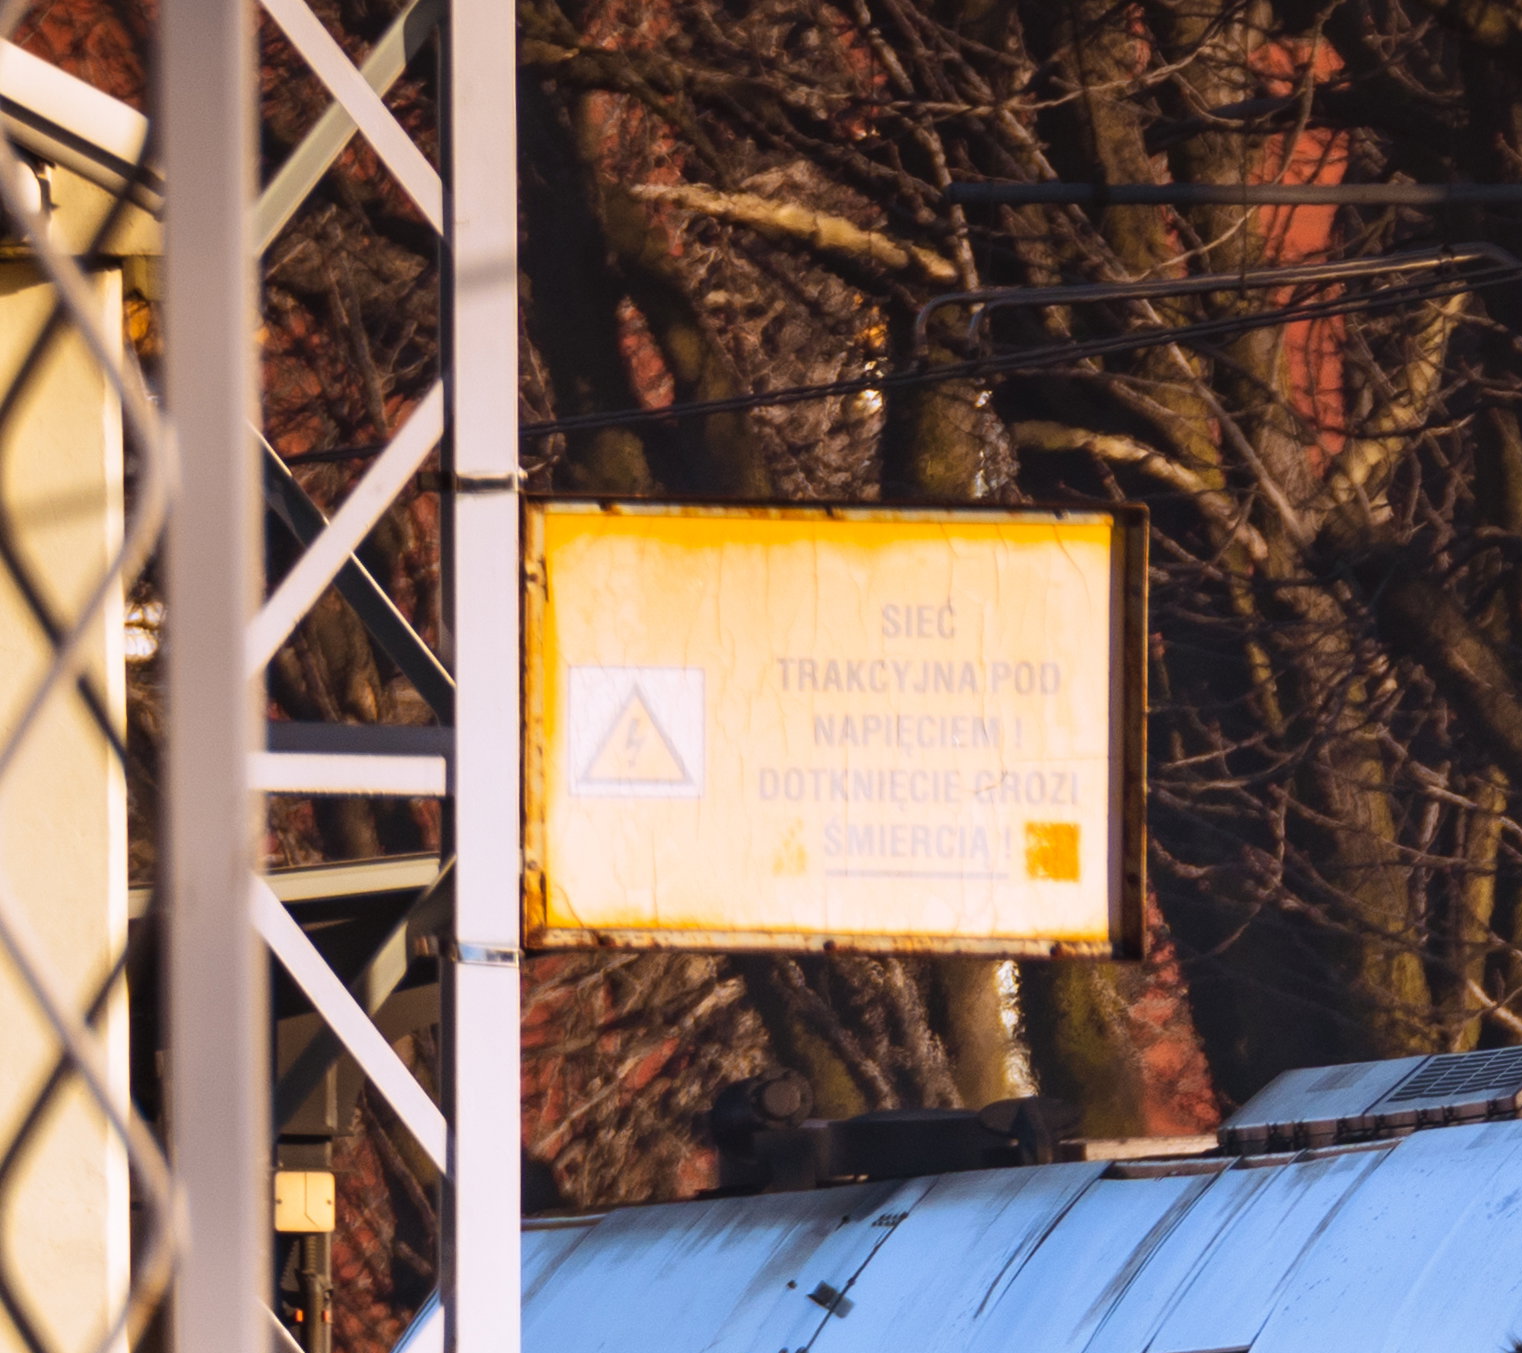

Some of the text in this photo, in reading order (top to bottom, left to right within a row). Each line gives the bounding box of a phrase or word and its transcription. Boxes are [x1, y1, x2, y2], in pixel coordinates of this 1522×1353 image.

[776, 657, 1062, 696] TRAKCYJNA POD
[813, 713, 999, 757] NAPIĘCIEM
[758, 767, 1080, 811] DOTKNIĘCIE GROZI
[824, 815, 990, 868] ŚMIERCIĄ
